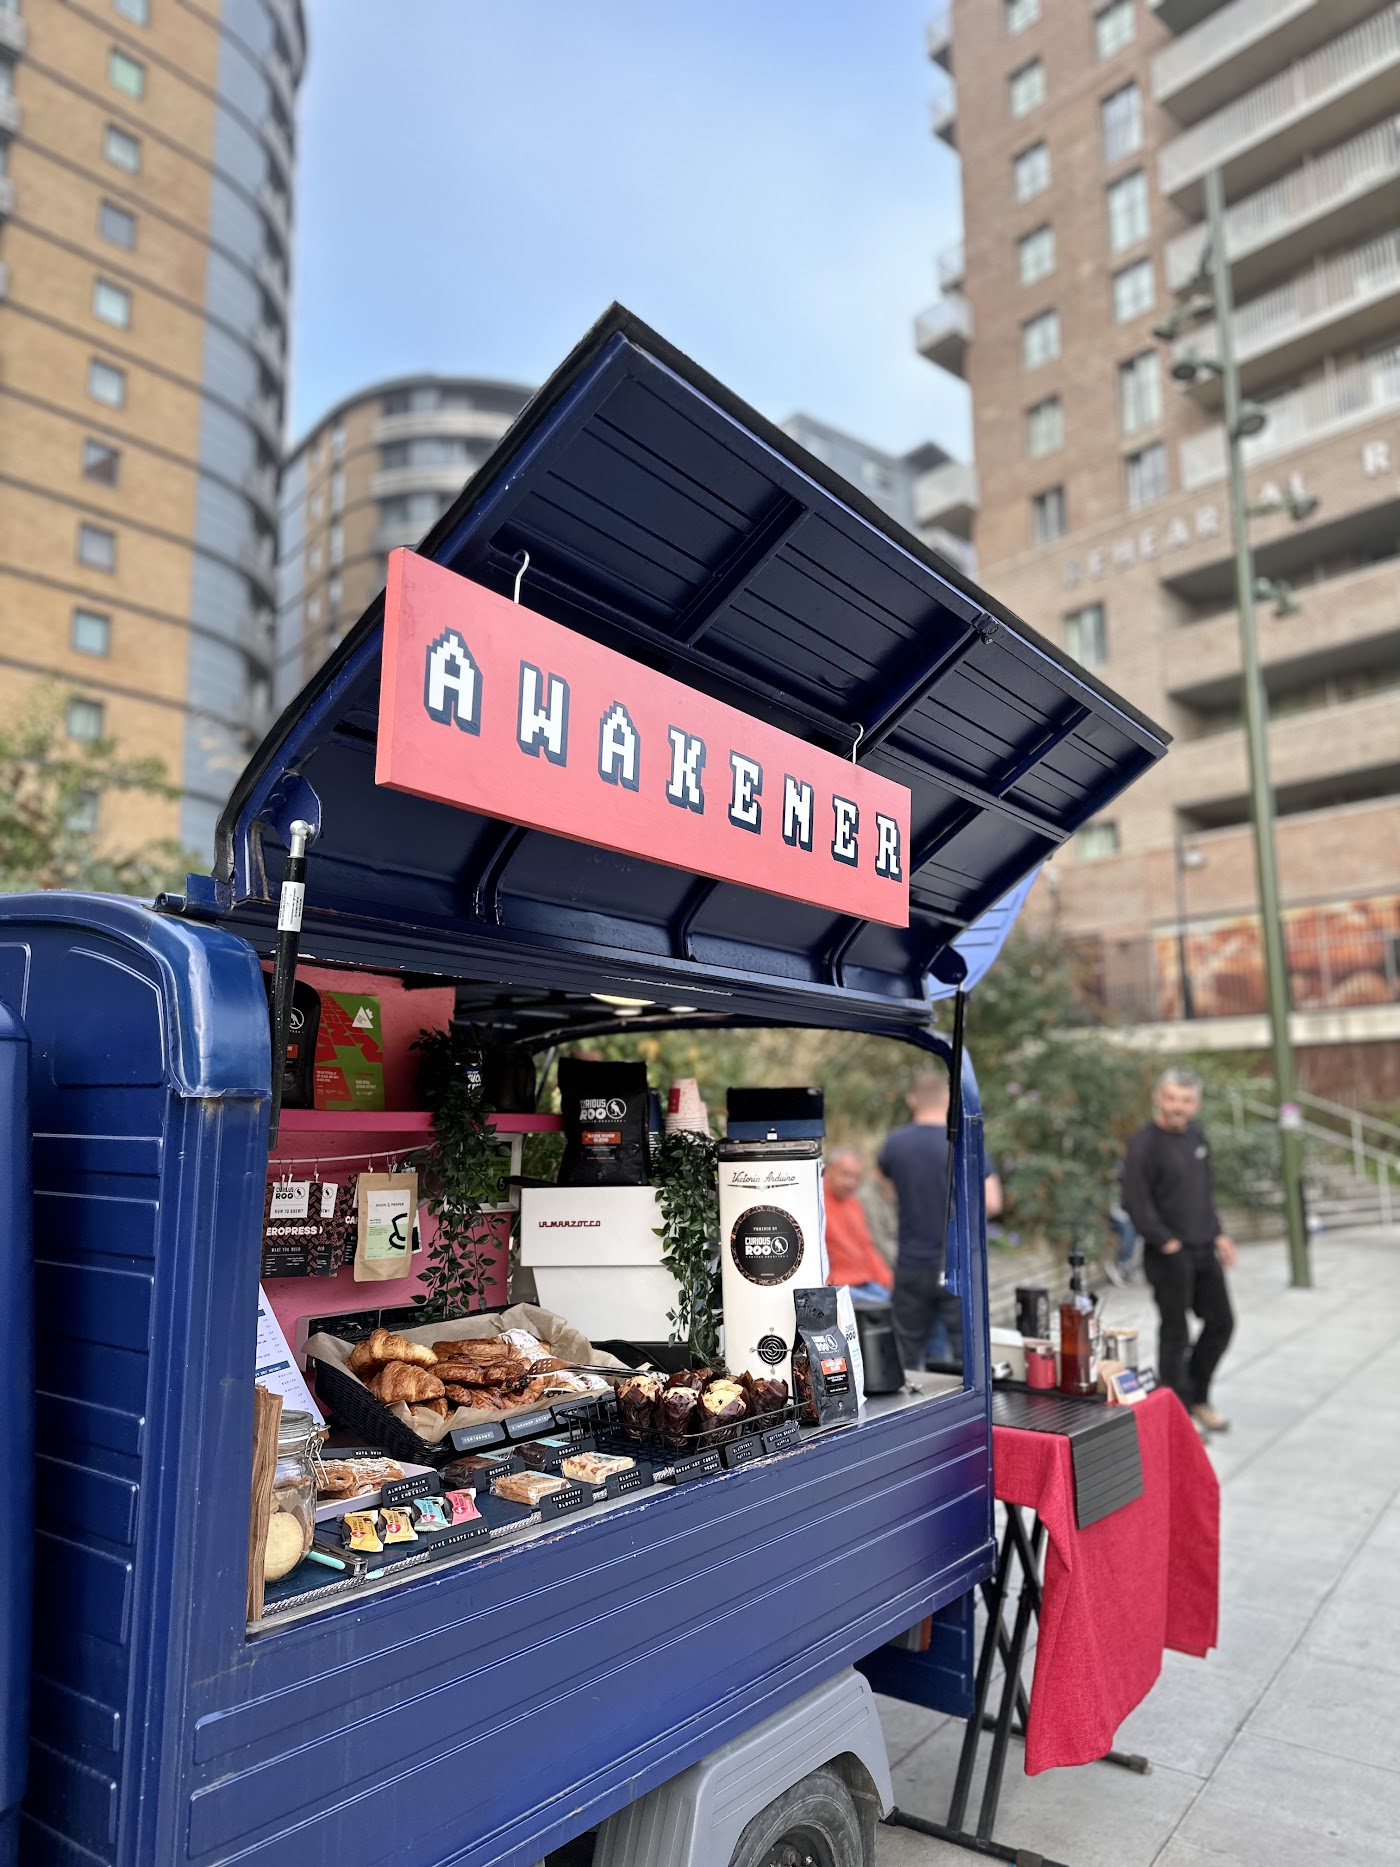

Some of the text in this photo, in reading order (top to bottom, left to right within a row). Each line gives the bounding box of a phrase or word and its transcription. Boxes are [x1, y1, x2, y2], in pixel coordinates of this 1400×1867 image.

[1063, 470, 1308, 588] REHEARAL
[423, 626, 903, 883] AWAKENER
[580, 1108, 607, 1120] ROO
[732, 1171, 795, 1183] Victoria Arduino
[745, 1237, 771, 1245] CURIOUS
[745, 1245, 772, 1256] ROO
[387, 1479, 426, 1495] ALMOND PAIN
[401, 1486, 429, 1499] CHOCOLAT
[430, 1528, 489, 1550] VIVE PROTEIN BAR
